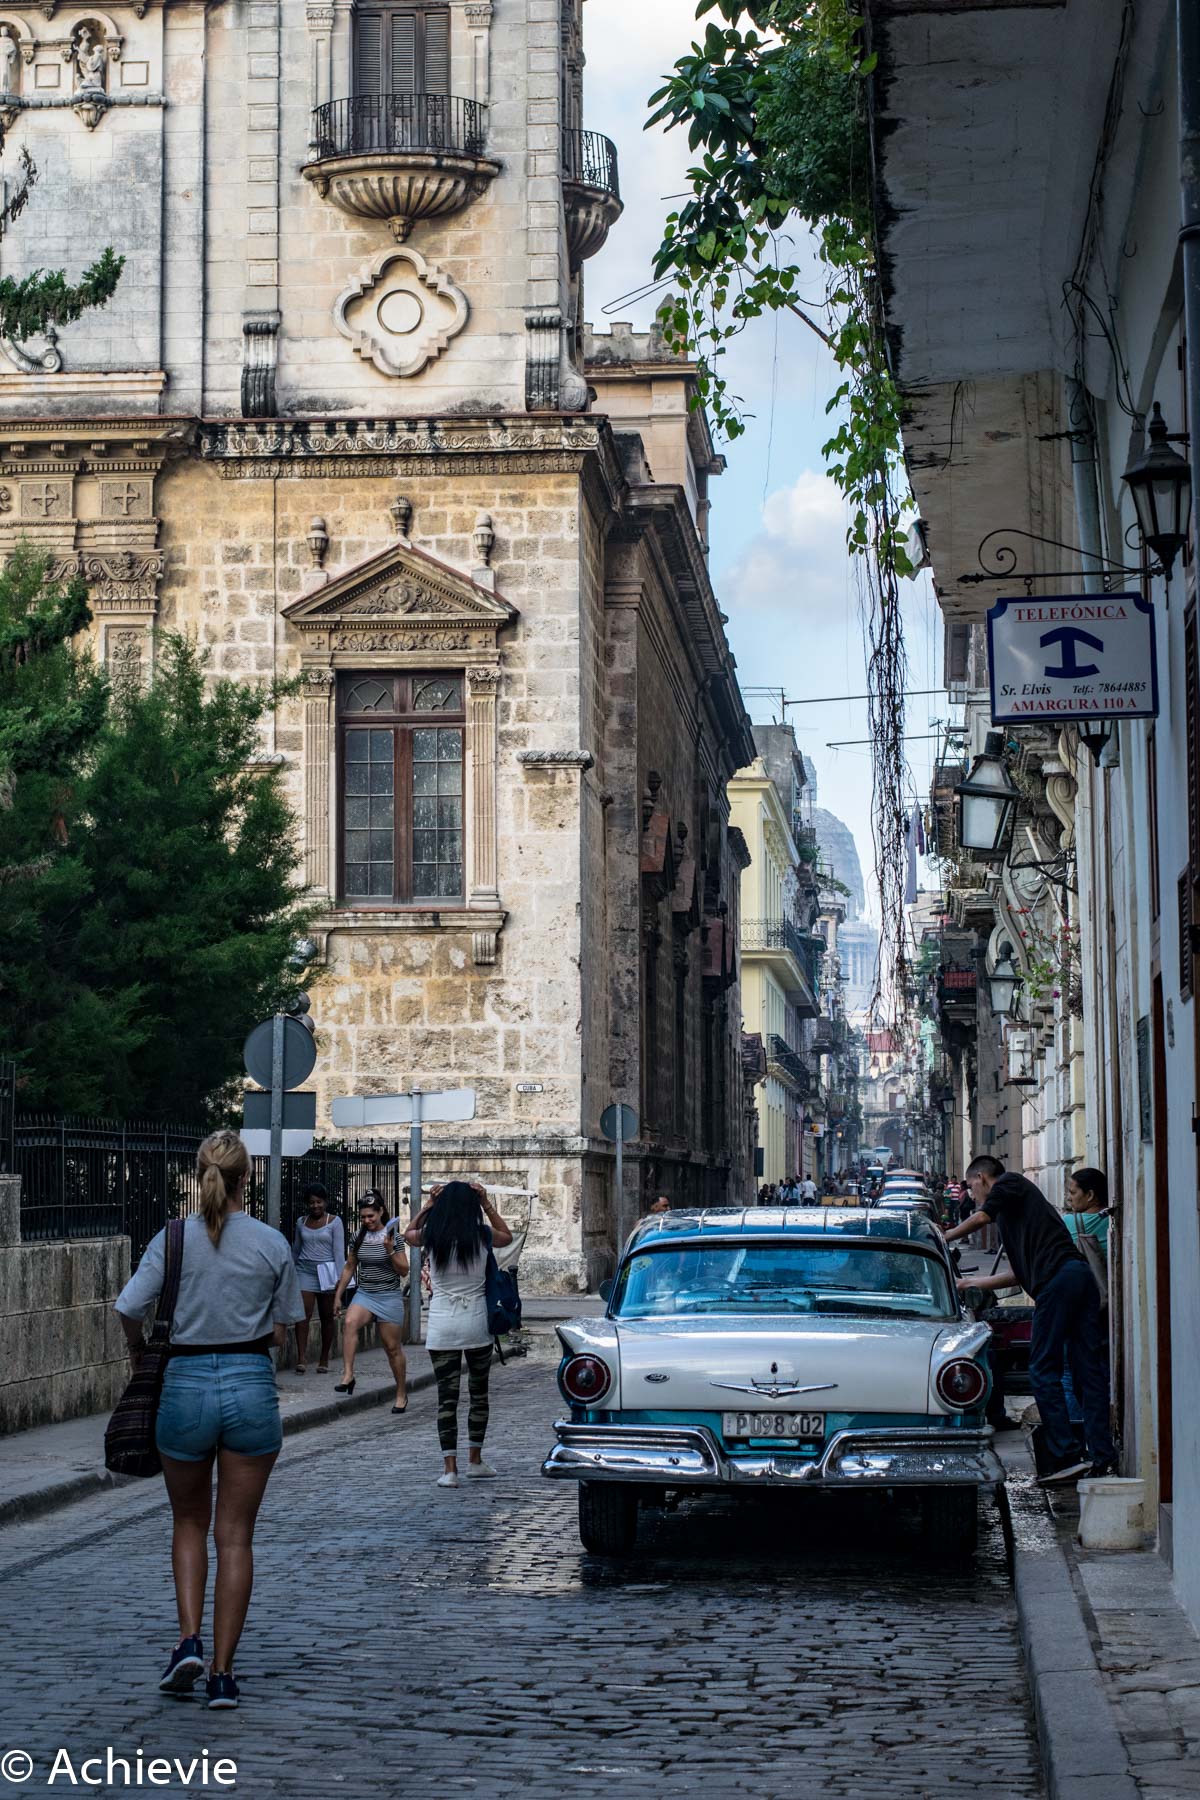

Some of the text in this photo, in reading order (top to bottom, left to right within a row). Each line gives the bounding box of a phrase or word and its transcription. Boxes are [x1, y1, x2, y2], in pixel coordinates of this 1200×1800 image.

[1015, 604, 1127, 621] TELEFÓNICA
[1000, 685, 1017, 696] Sr.
[1022, 683, 1052, 695] Elvis
[1099, 682, 1147, 693] 78644885
[1010, 698, 1137, 712] AMARGURA 110 A
